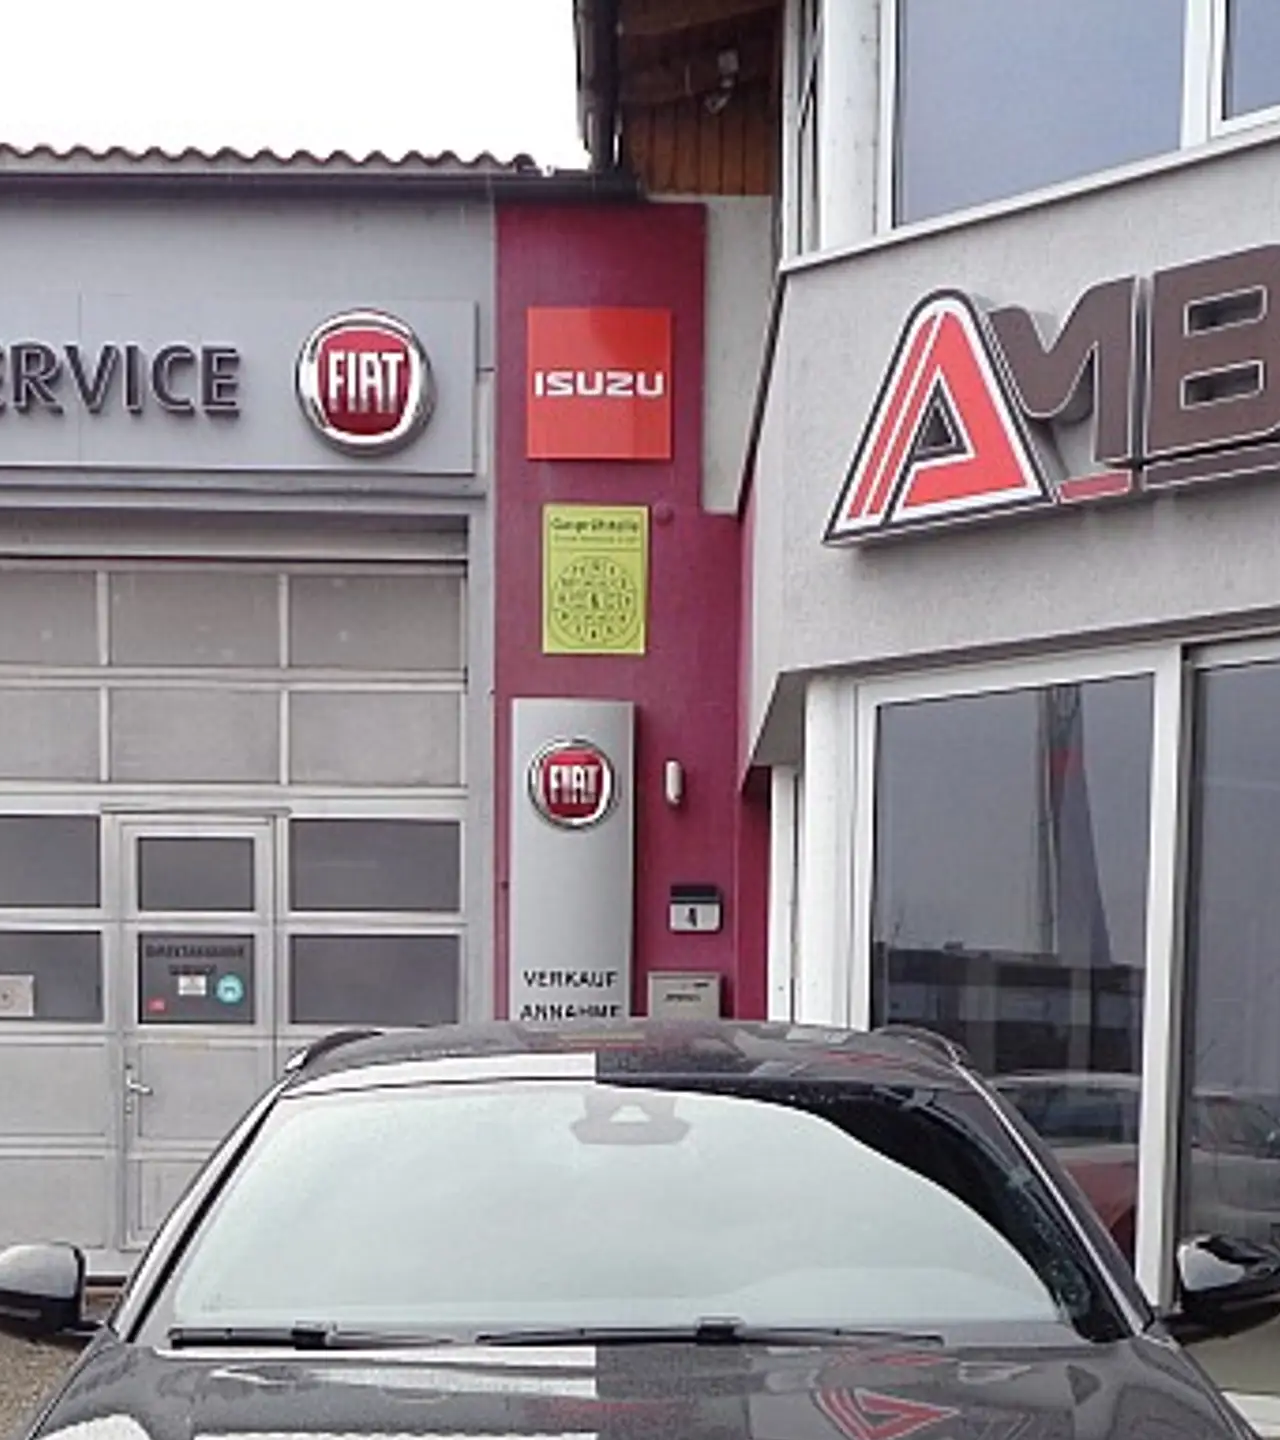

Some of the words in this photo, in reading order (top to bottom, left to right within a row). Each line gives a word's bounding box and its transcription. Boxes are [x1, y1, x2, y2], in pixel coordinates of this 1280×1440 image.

[328, 350, 406, 414] FIAT
[534, 370, 664, 397] ISUZU
[549, 765, 600, 804] FIAT
[523, 970, 618, 988] VERKAUF
